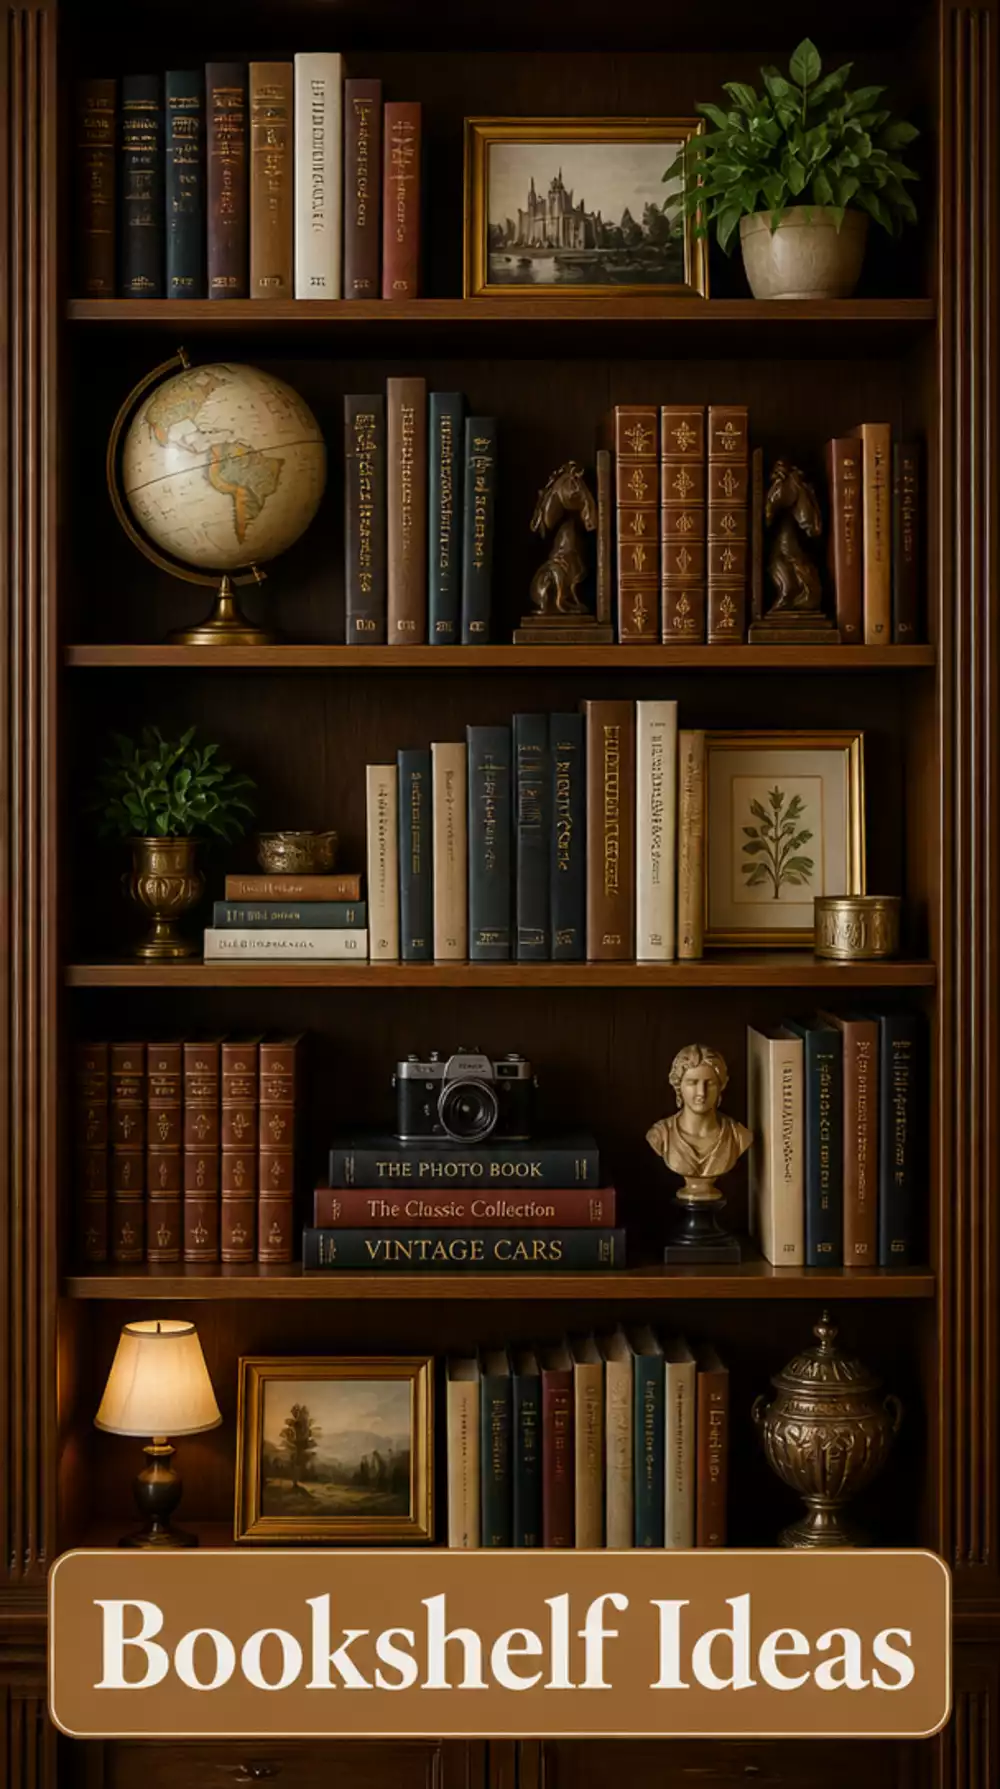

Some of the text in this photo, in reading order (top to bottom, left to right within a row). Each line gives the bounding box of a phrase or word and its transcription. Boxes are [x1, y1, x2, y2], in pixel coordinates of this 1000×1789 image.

[376, 1162, 543, 1177] THE PHOTO BOOK
[367, 1199, 556, 1217] The Classic Collection
[364, 1239, 563, 1261] VINTAGE CARS
